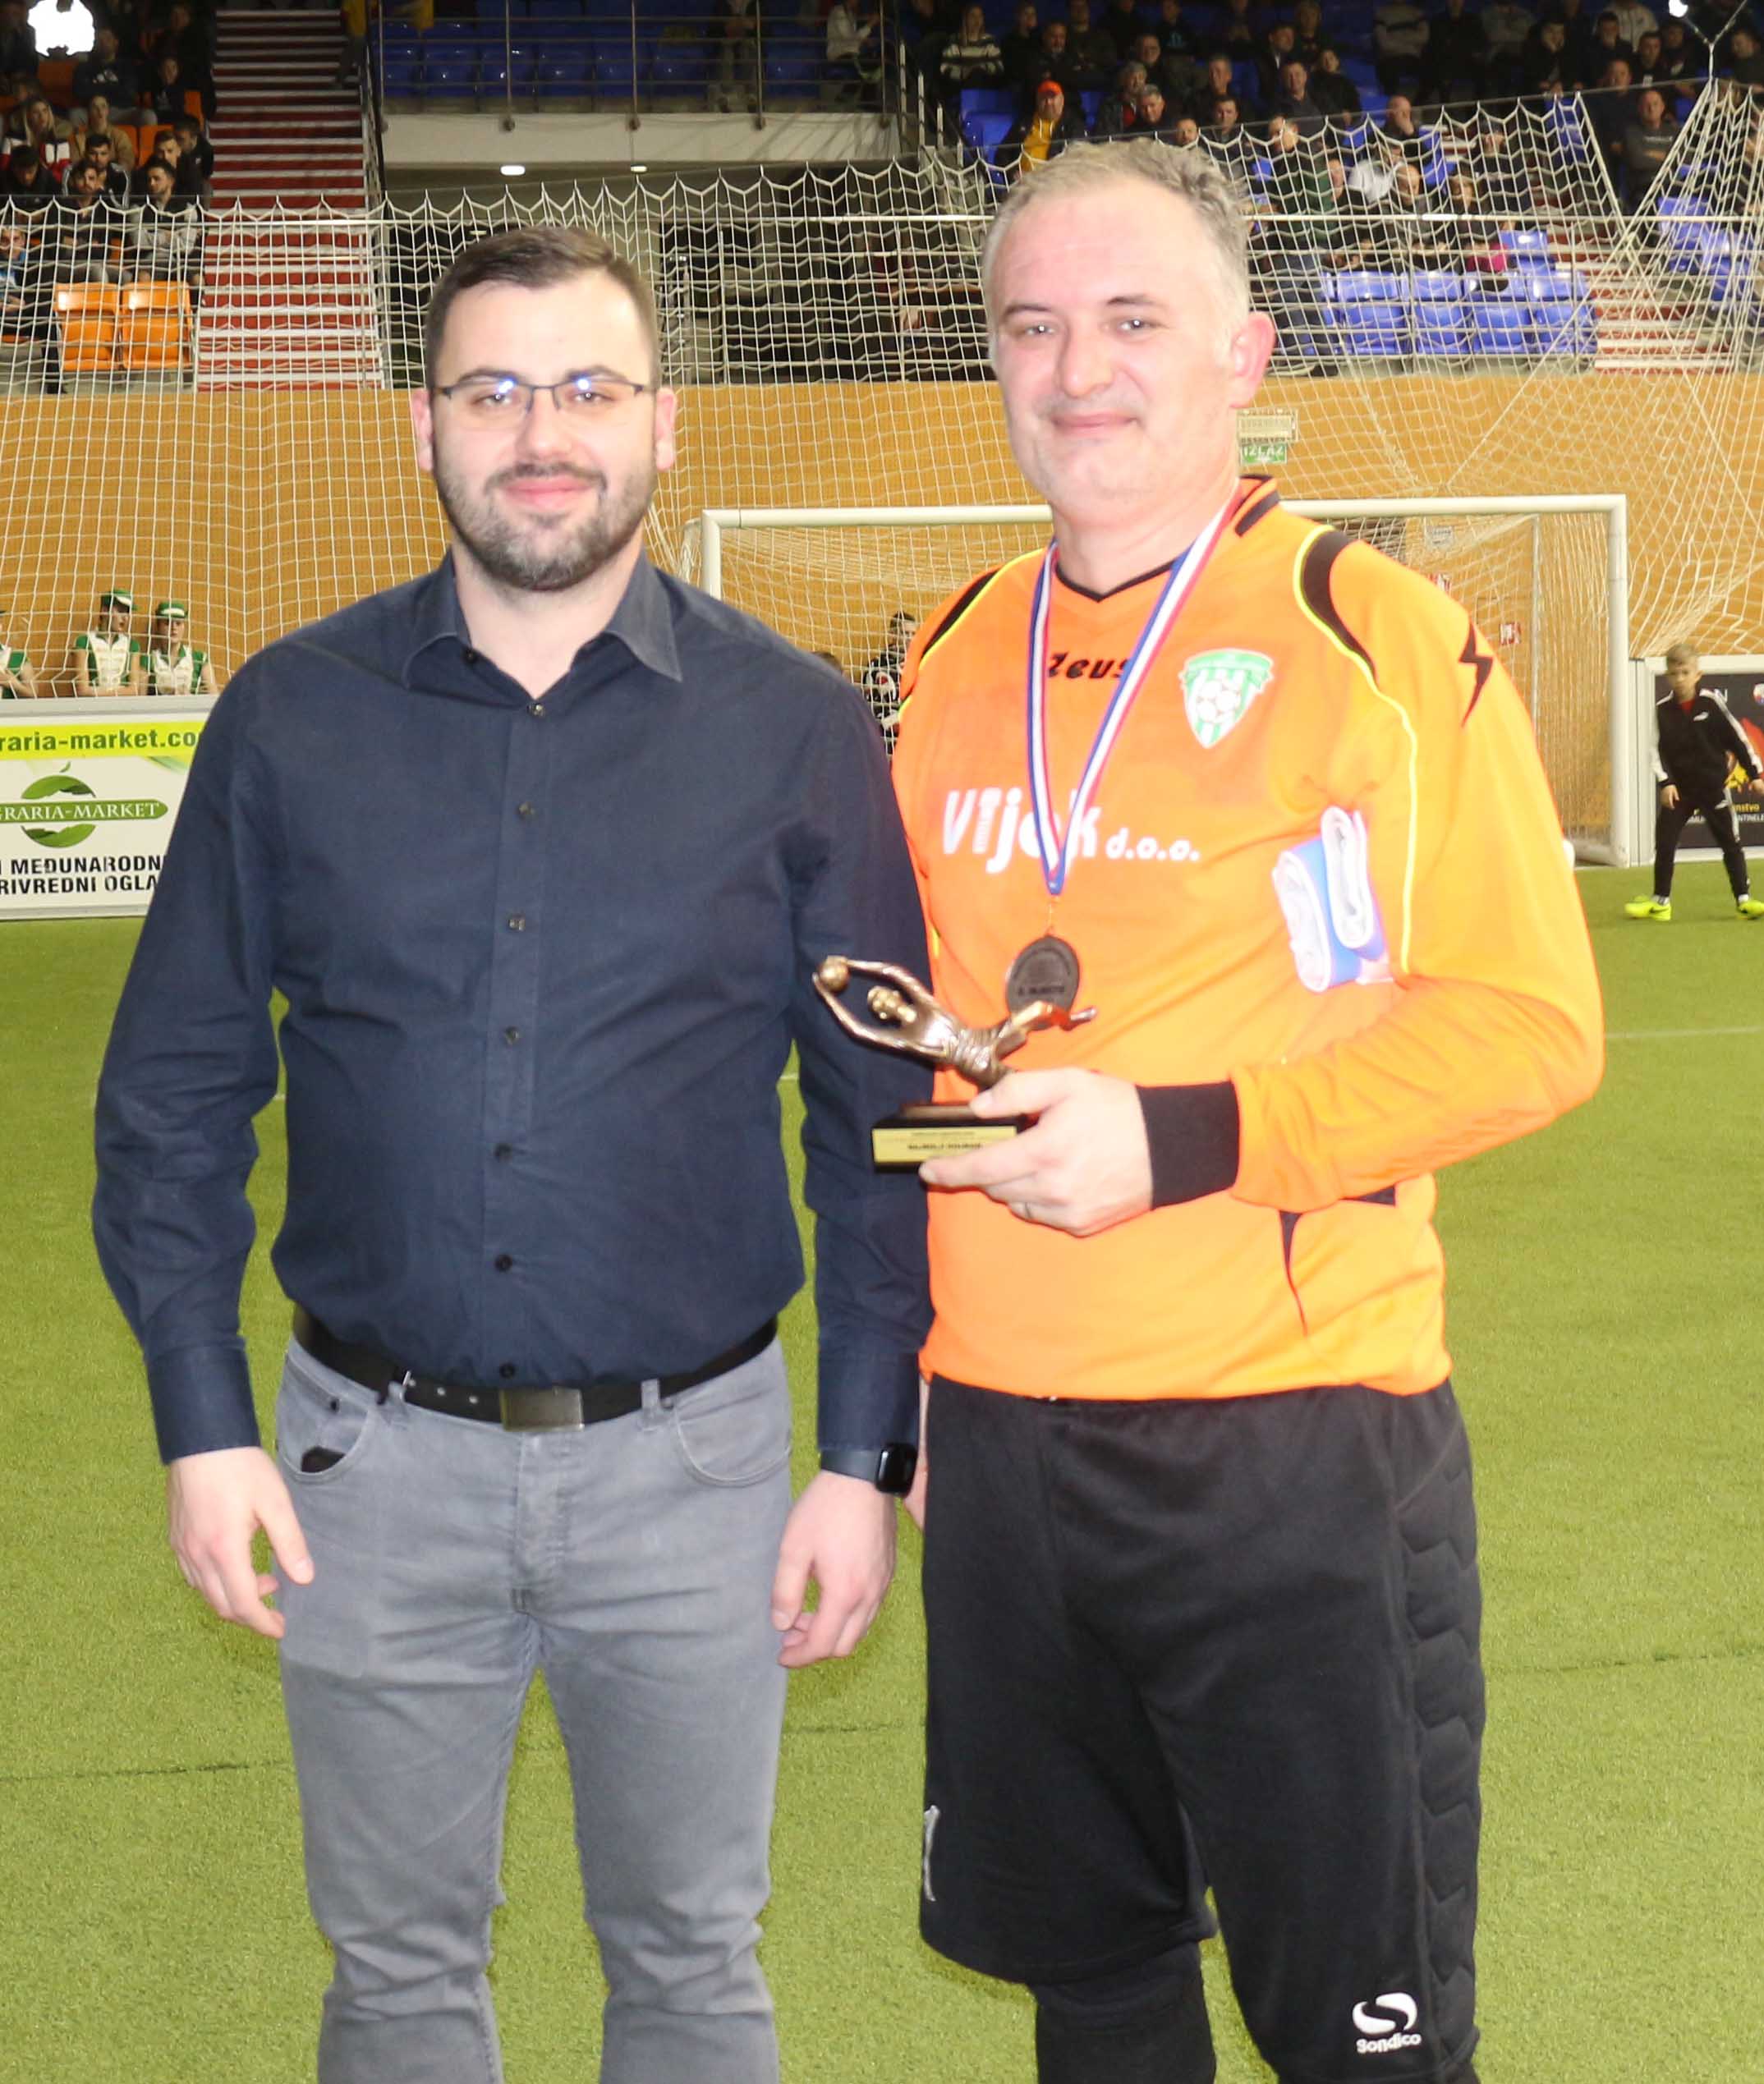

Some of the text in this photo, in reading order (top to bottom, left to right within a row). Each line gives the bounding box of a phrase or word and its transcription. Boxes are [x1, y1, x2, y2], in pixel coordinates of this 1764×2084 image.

[0, 801, 159, 820] RARIA-MARKET
[1105, 827, 1201, 861] d.o.o.
[1356, 2032, 1422, 2054] Sondico
